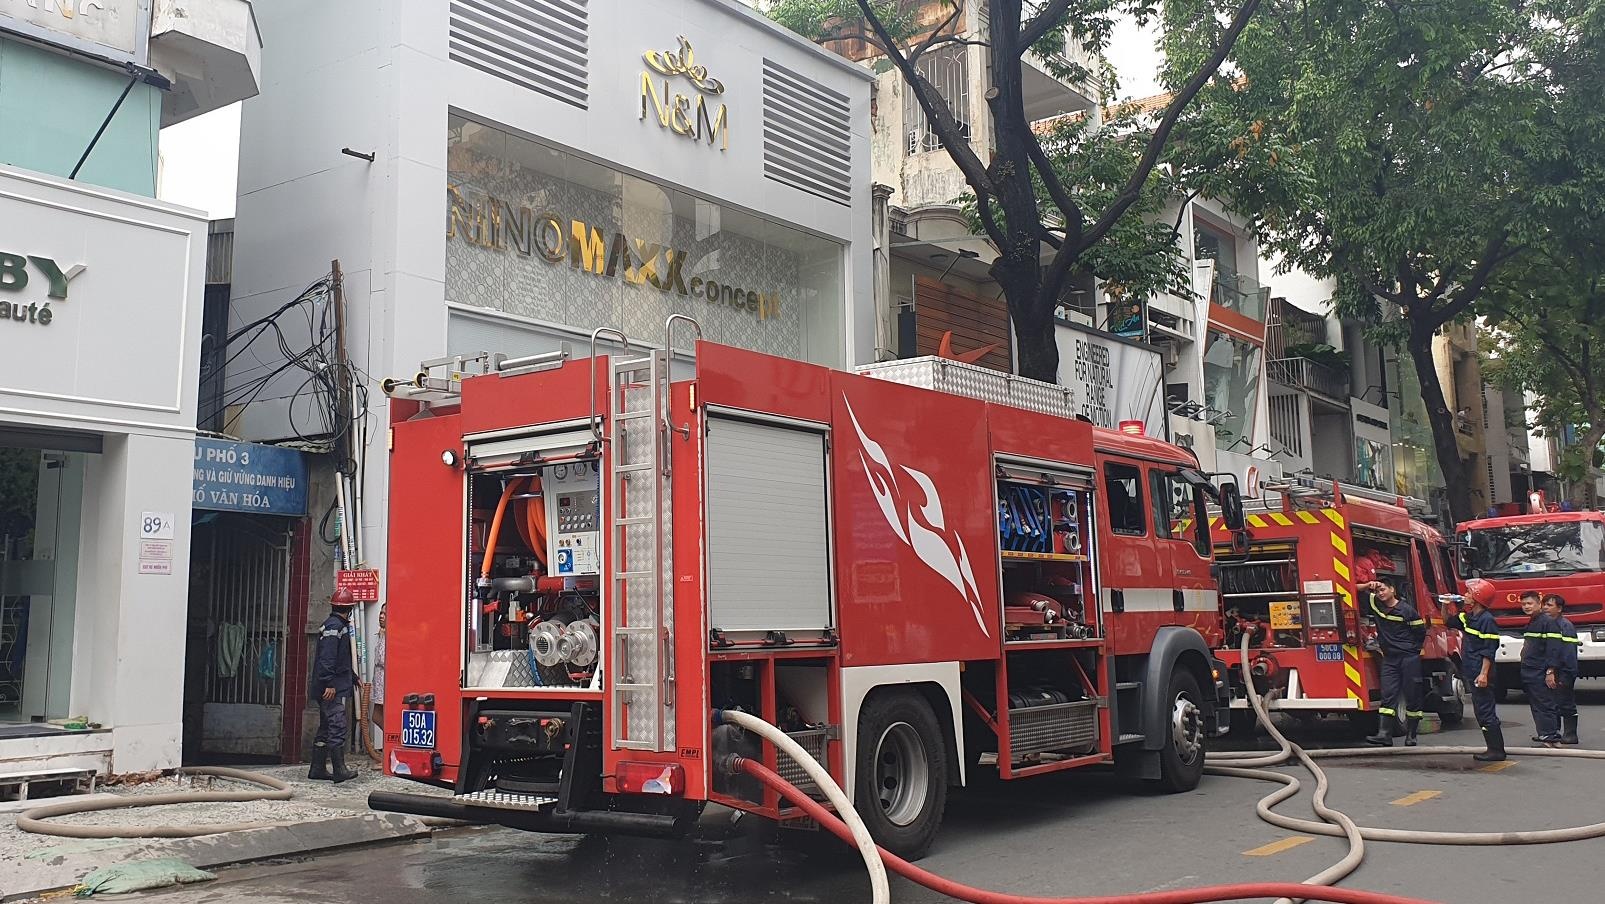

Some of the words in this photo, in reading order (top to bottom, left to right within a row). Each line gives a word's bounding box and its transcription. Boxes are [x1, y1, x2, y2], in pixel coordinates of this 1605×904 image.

[639, 71, 729, 151] N&M
[1076, 339, 1110, 368] ENGINEERED
[1075, 360, 1088, 383] FOR
[1087, 363, 1114, 389] NATURAL
[1086, 383, 1106, 408] RANGE
[206, 444, 237, 464] PHỐ
[241, 452, 250, 465] 3
[206, 468, 217, 482] VÀ
[256, 474, 277, 488] DANH
[277, 475, 296, 491] HIỆU
[210, 488, 239, 505] VĂN
[242, 491, 271, 508] HÓA
[409, 712, 427, 729] 50A
[402, 728, 433, 746] 015.32
